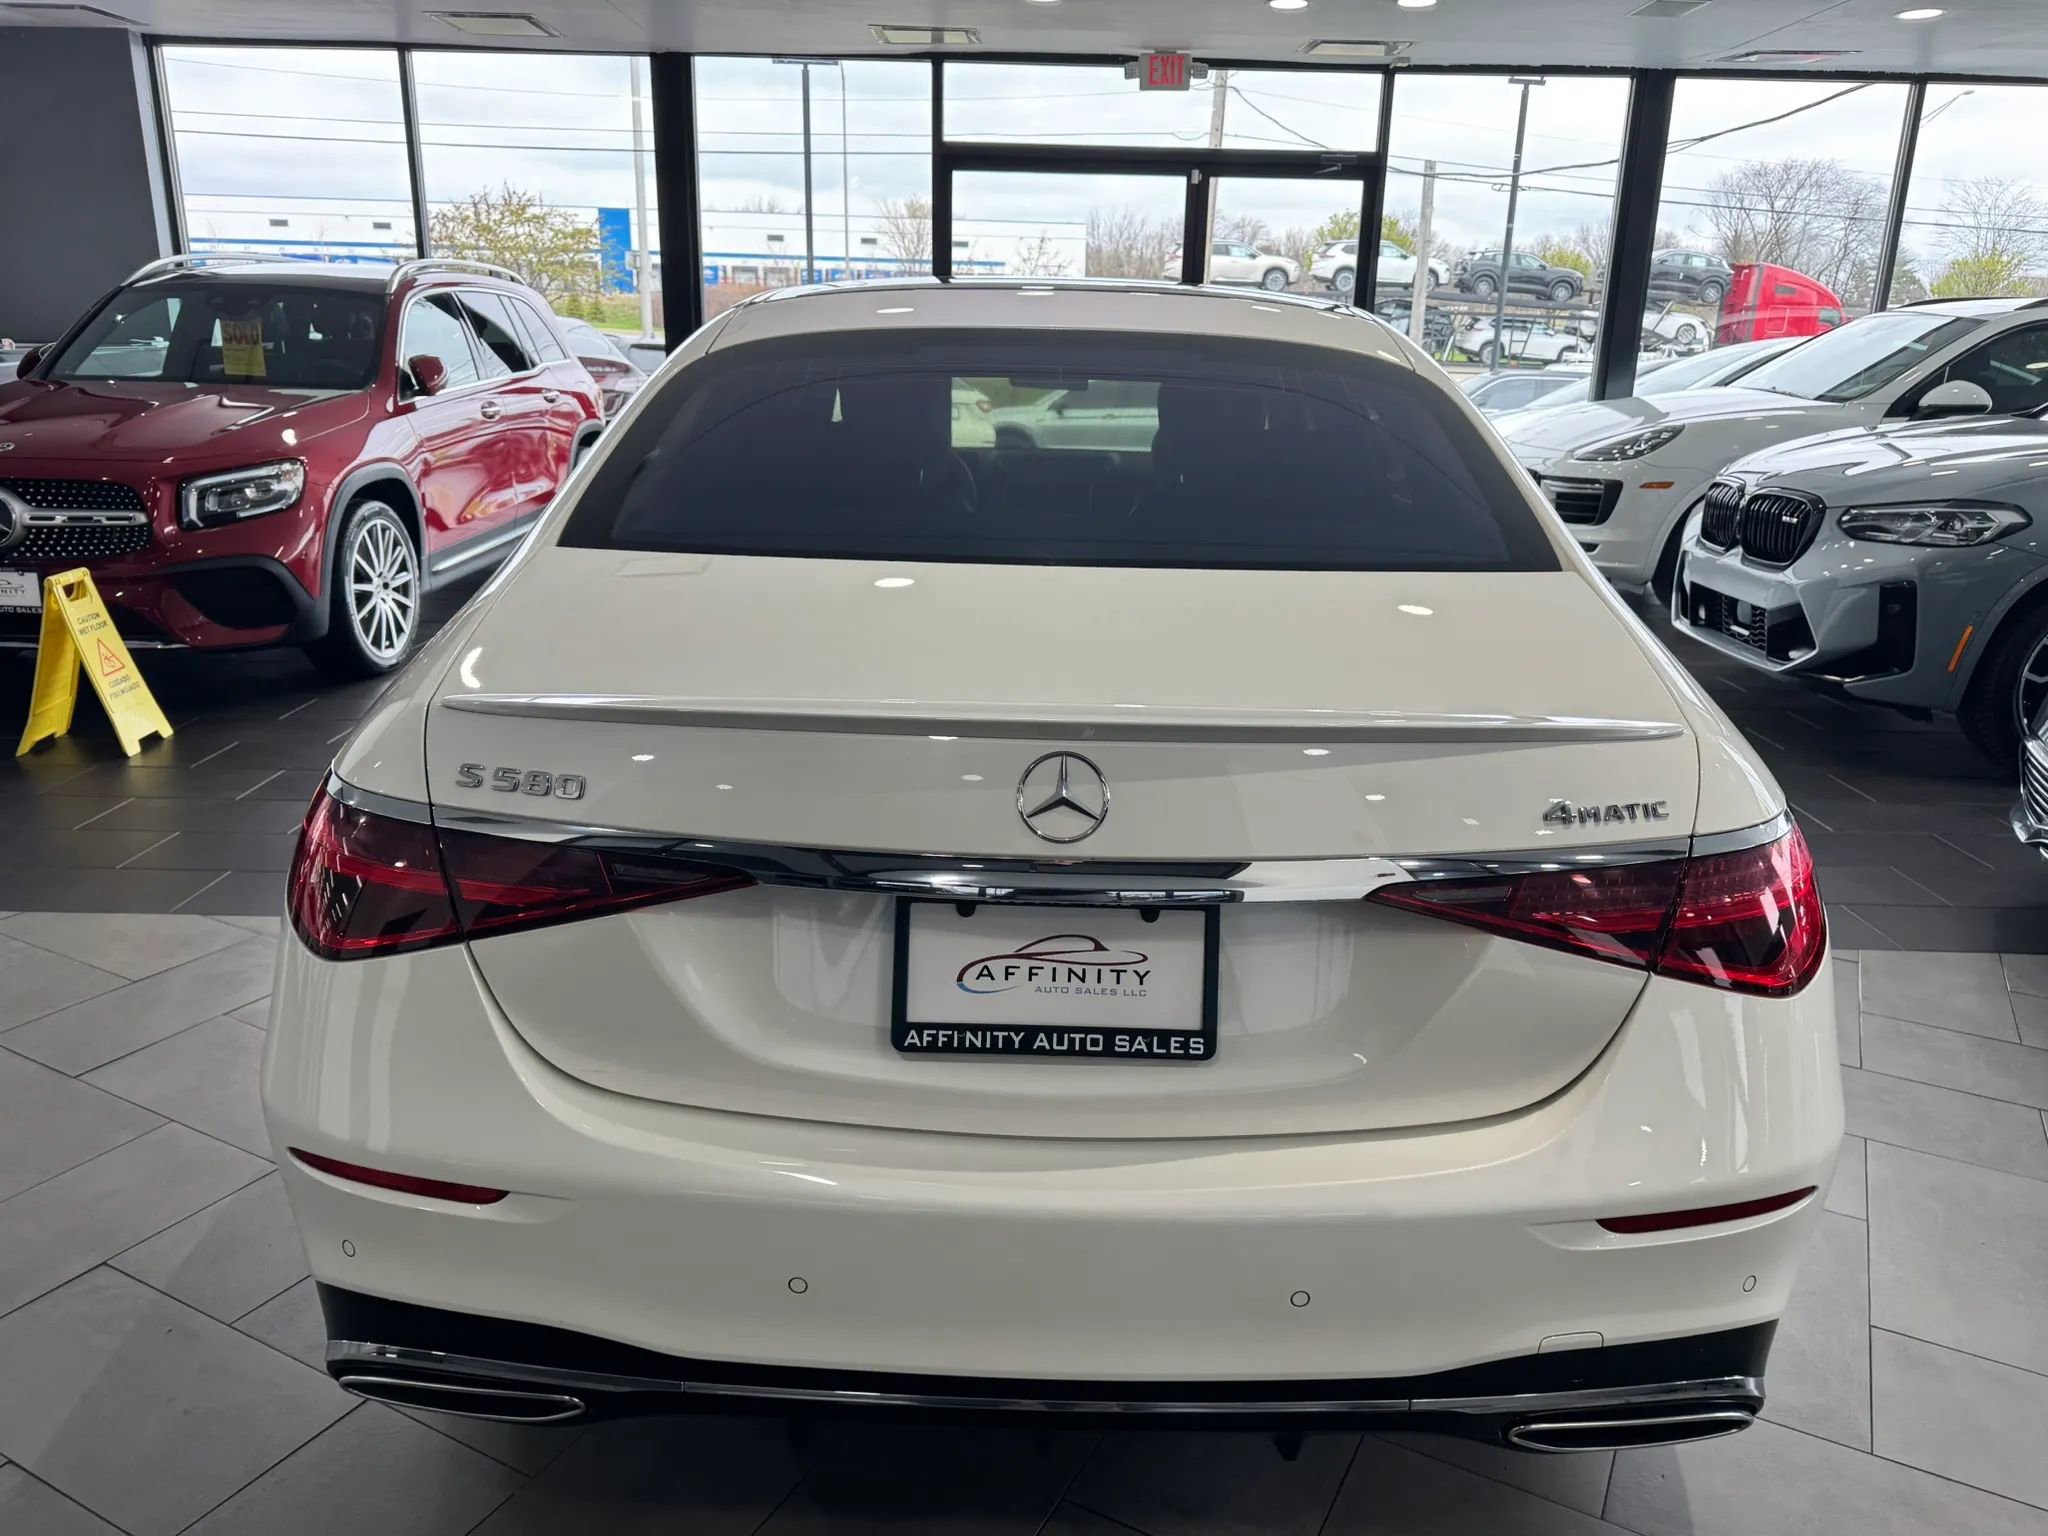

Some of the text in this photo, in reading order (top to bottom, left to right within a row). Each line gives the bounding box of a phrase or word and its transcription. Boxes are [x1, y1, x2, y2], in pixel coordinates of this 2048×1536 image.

[1148, 54, 1185, 86] EXIT
[222, 321, 261, 346] SOLD
[16, 606, 43, 614] SALES
[77, 612, 101, 625] CAUTION
[78, 620, 108, 635] WET FLOOR
[455, 762, 587, 800] S 580
[1542, 799, 1670, 827] 4MATIC
[975, 964, 1152, 986] AFFINITY
[1034, 985, 1147, 998] AUTO SALES LLC
[903, 1029, 1205, 1055] AFFINITY AUTO SALES
